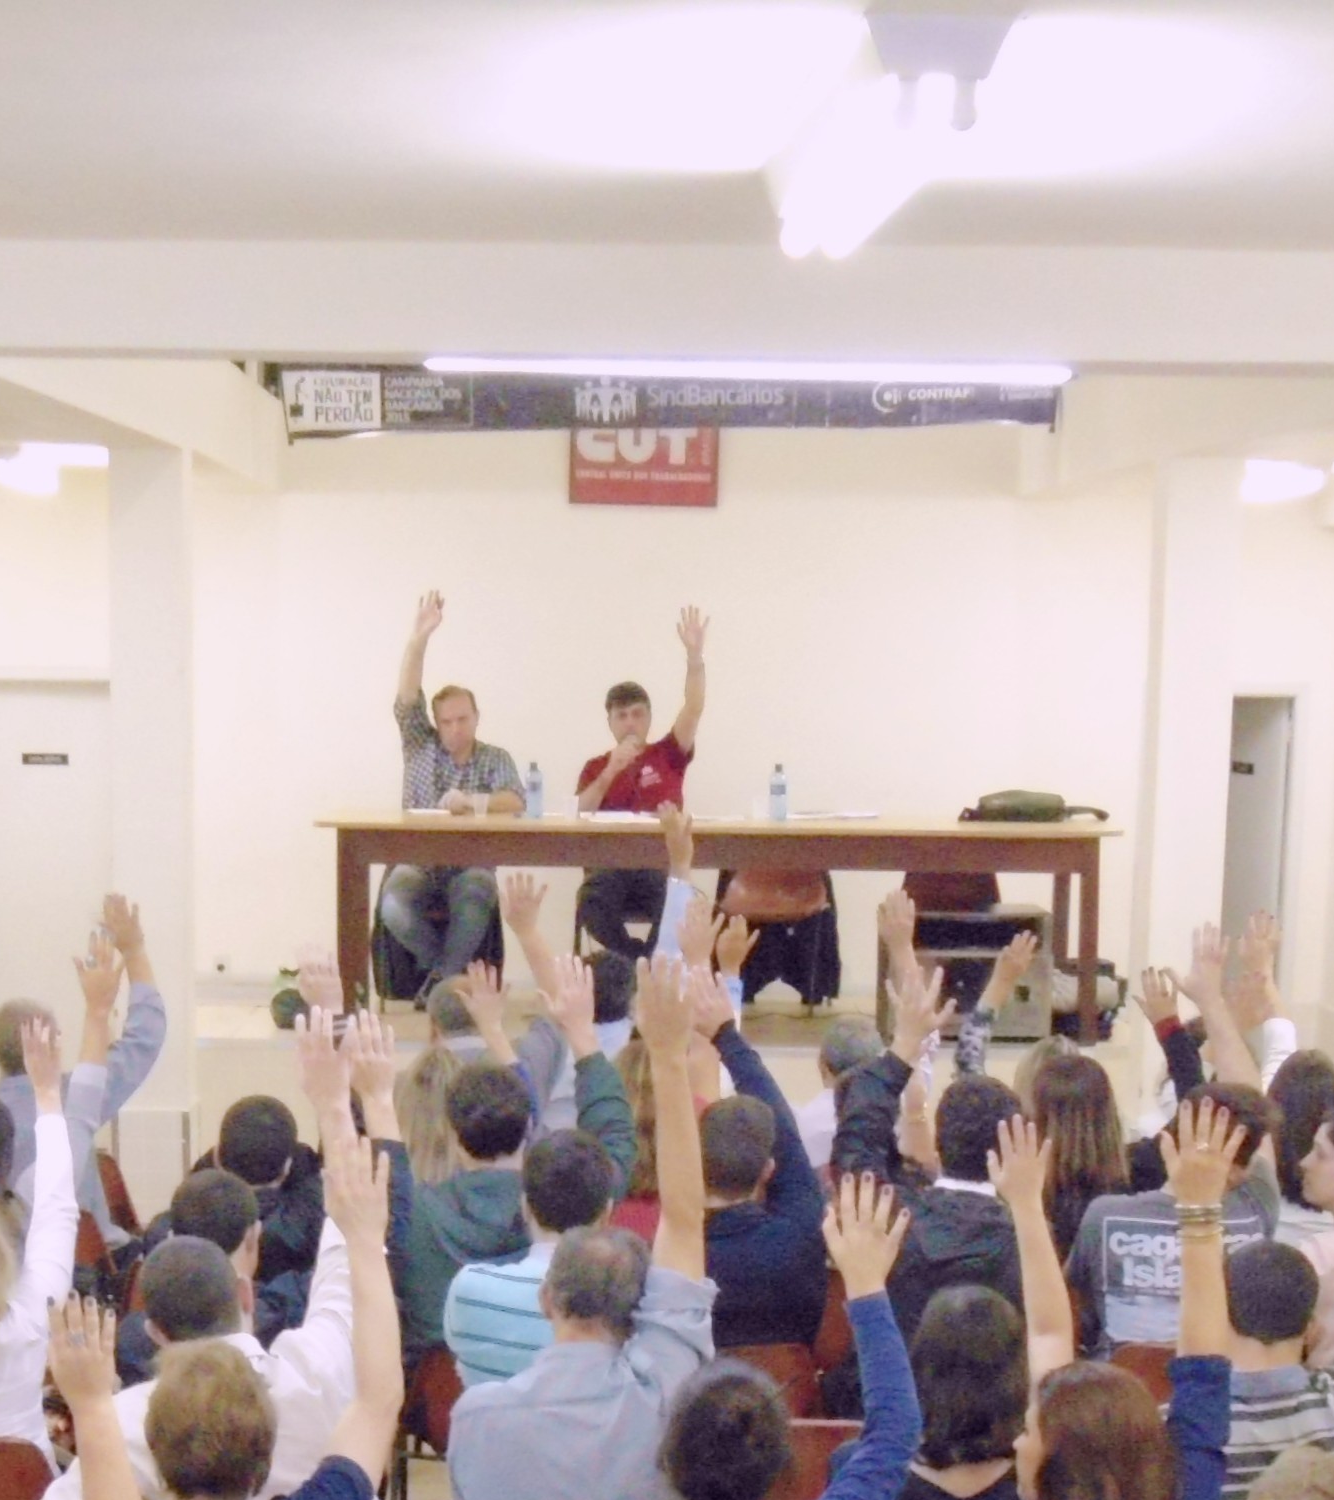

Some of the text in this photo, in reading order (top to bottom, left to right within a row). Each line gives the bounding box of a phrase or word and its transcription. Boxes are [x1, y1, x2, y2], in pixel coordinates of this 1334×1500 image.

[314, 387, 373, 404] NÃO TEM
[647, 382, 785, 406] SindBancários
[314, 403, 373, 423] PERDÃO
[576, 427, 698, 464] CUT
